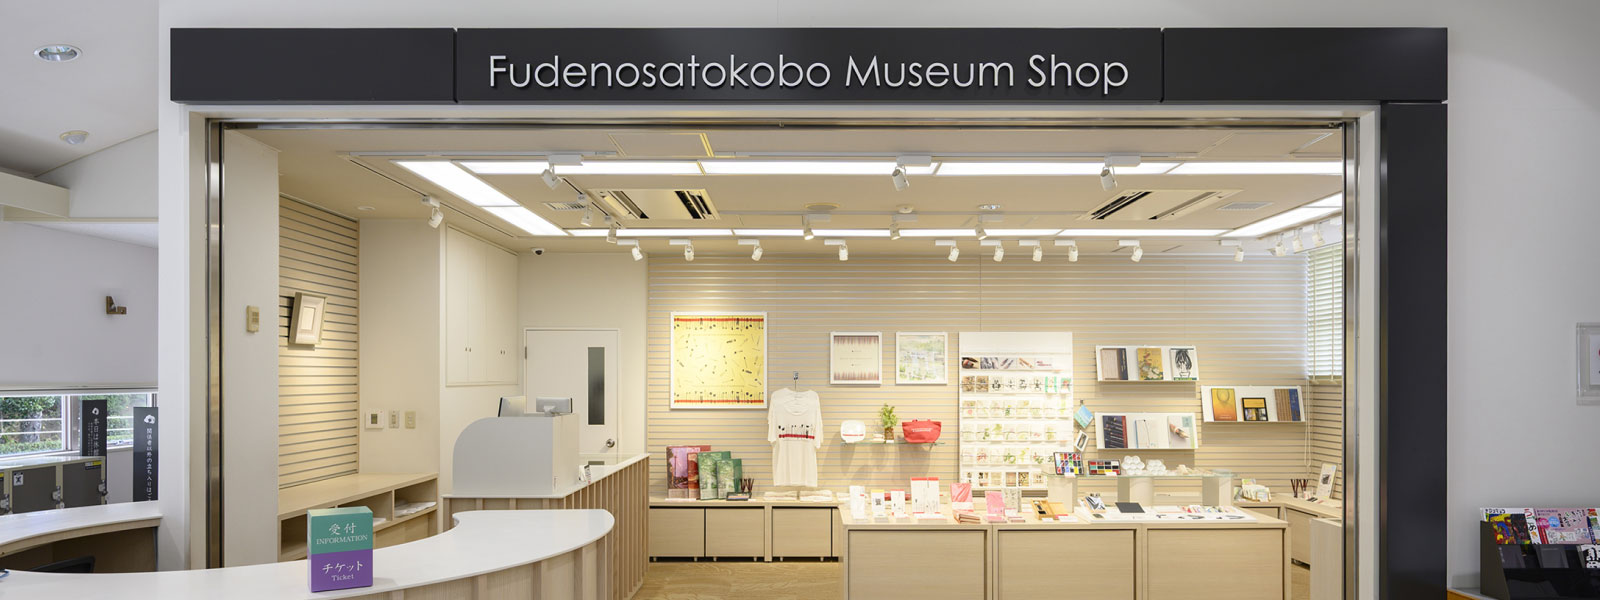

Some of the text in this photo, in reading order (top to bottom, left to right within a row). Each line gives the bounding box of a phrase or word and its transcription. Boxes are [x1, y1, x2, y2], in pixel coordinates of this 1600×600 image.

[489, 54, 1129, 95] Fudenosatokobo Museum Shop
[328, 522, 357, 535] 受付
[316, 534, 368, 544] INFORMATION
[322, 560, 363, 574] チケット
[331, 573, 354, 581] Ticket
